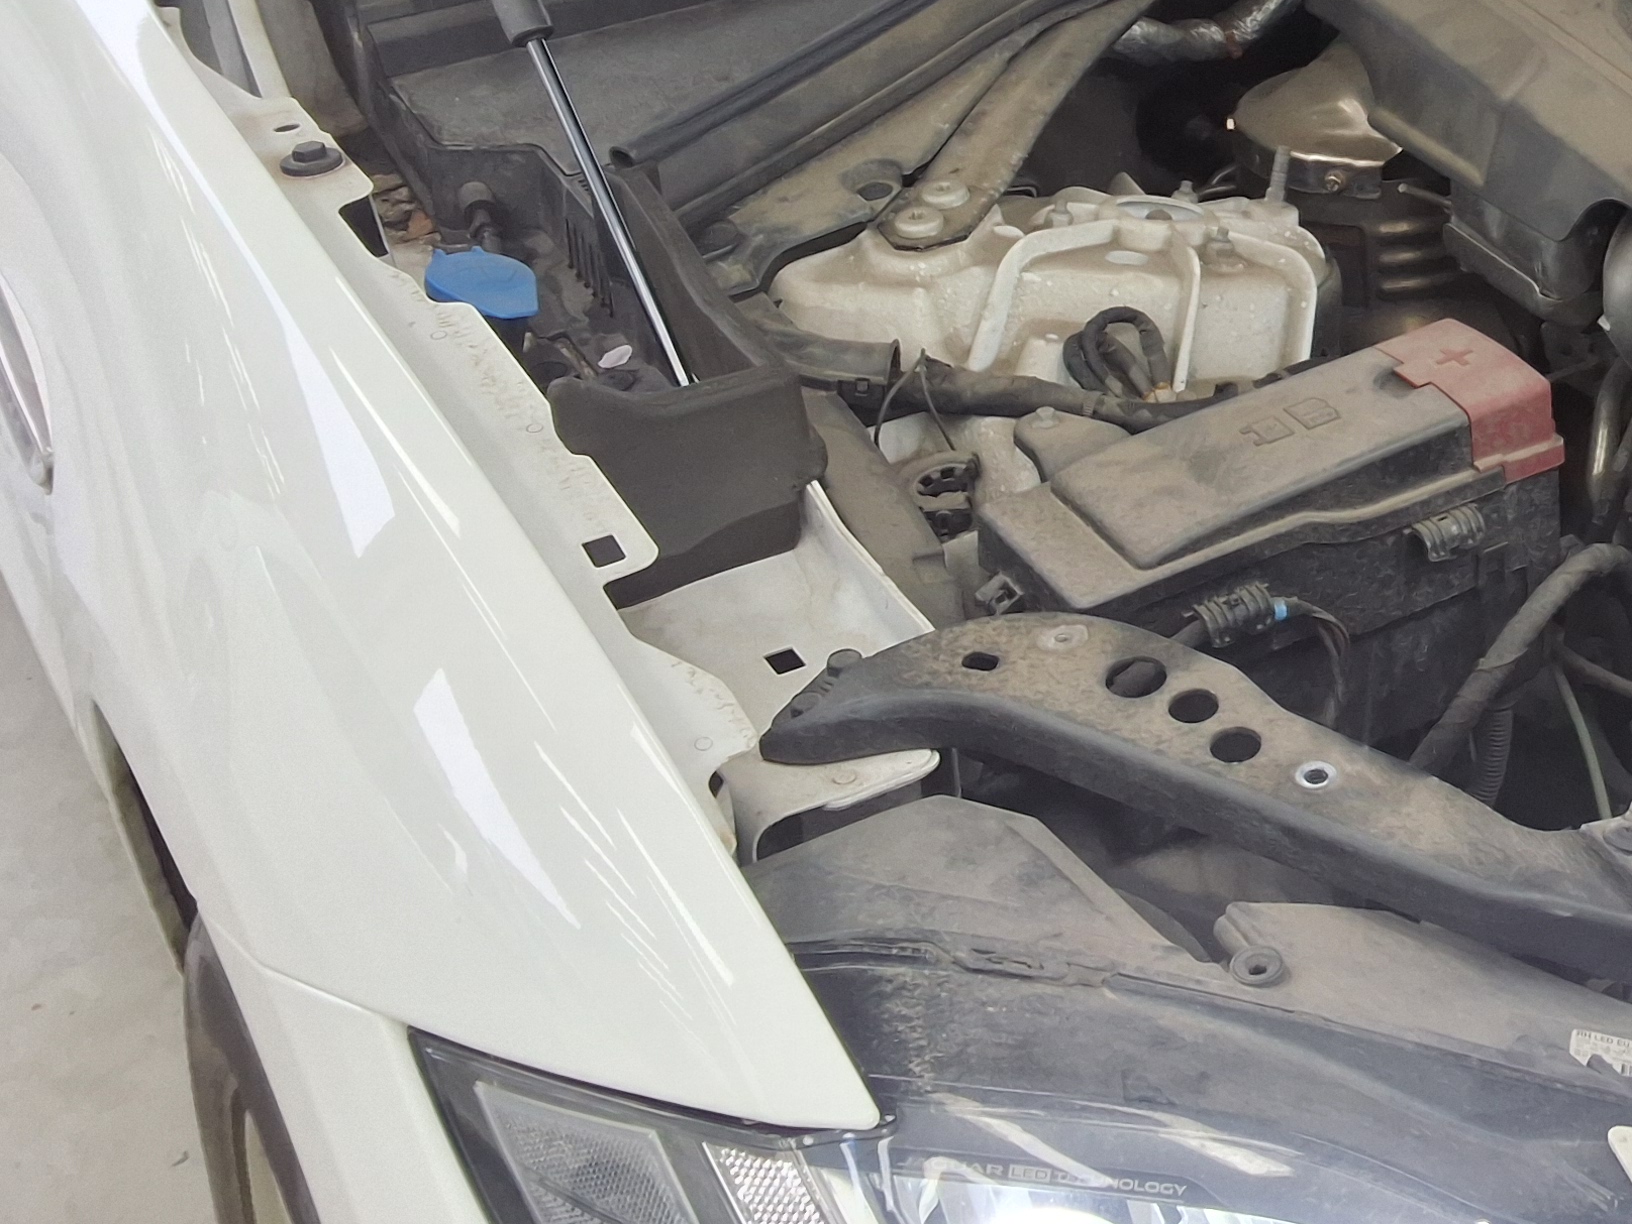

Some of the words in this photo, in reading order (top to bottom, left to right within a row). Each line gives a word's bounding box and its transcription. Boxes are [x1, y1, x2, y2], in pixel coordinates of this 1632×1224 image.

[1594, 1034, 1614, 1045] LED
[1011, 1165, 1049, 1181] LED
[1053, 1169, 1188, 1197] TNOLOGY
